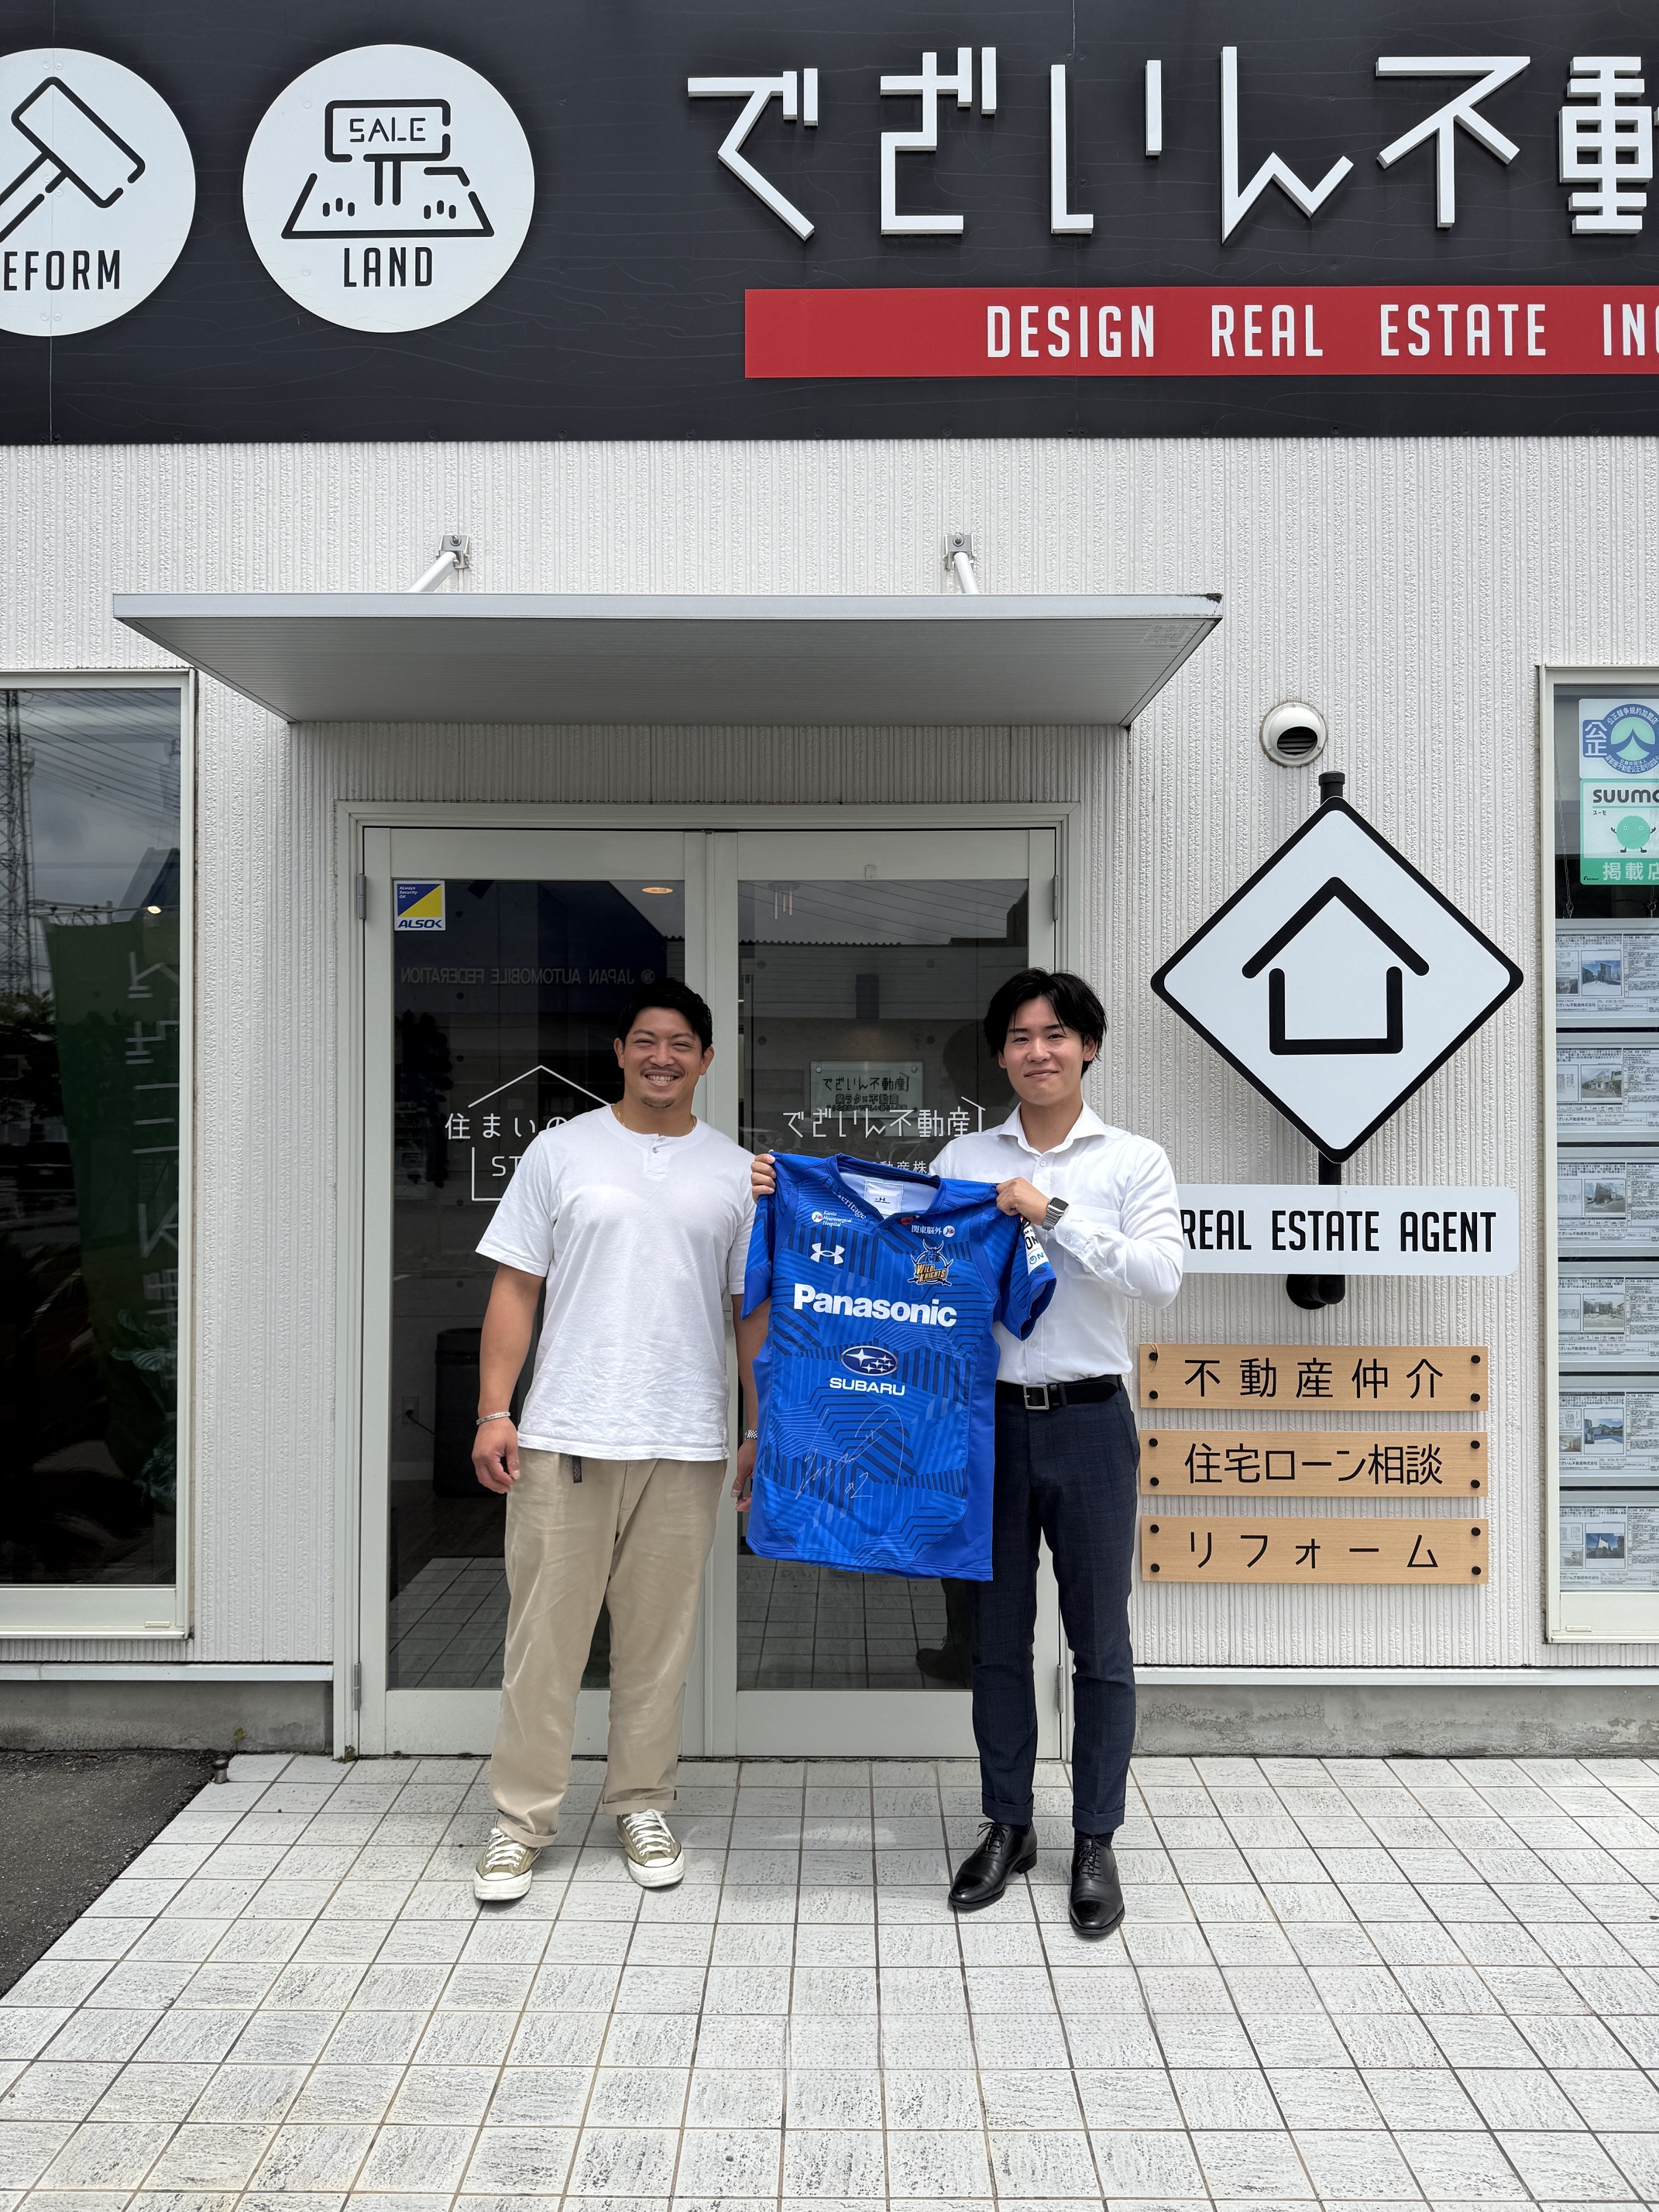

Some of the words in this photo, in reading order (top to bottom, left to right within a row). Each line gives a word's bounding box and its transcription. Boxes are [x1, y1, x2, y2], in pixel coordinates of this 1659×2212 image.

[349, 117, 427, 143] SALE
[343, 246, 433, 287] LAND
[987, 305, 1154, 358] DESIGN
[1211, 304, 1324, 357] REAL
[1380, 304, 1546, 356] ESTATE
[1603, 304, 1659, 356] IN
[1585, 721, 1608, 756] 公正
[1602, 861, 1659, 881] 掲載店
[397, 919, 442, 929] ALSOK
[823, 1077, 906, 1091] でざいん不動産
[782, 1106, 970, 1139] でざいん不動産
[1180, 1209, 1252, 1250] REAL
[1272, 1210, 1379, 1252] ESTATE
[1400, 1211, 1496, 1252] AGENT
[915, 1263, 934, 1275] WILD
[919, 1269, 946, 1283] KNIGHTS
[793, 1283, 957, 1328] Panasonic
[829, 1377, 905, 1396] SUBARU
[1184, 1357, 1444, 1399] 不動産仲介
[1184, 1443, 1443, 1486] 住宅ローン相談
[1190, 1531, 1438, 1569] リフォーム
